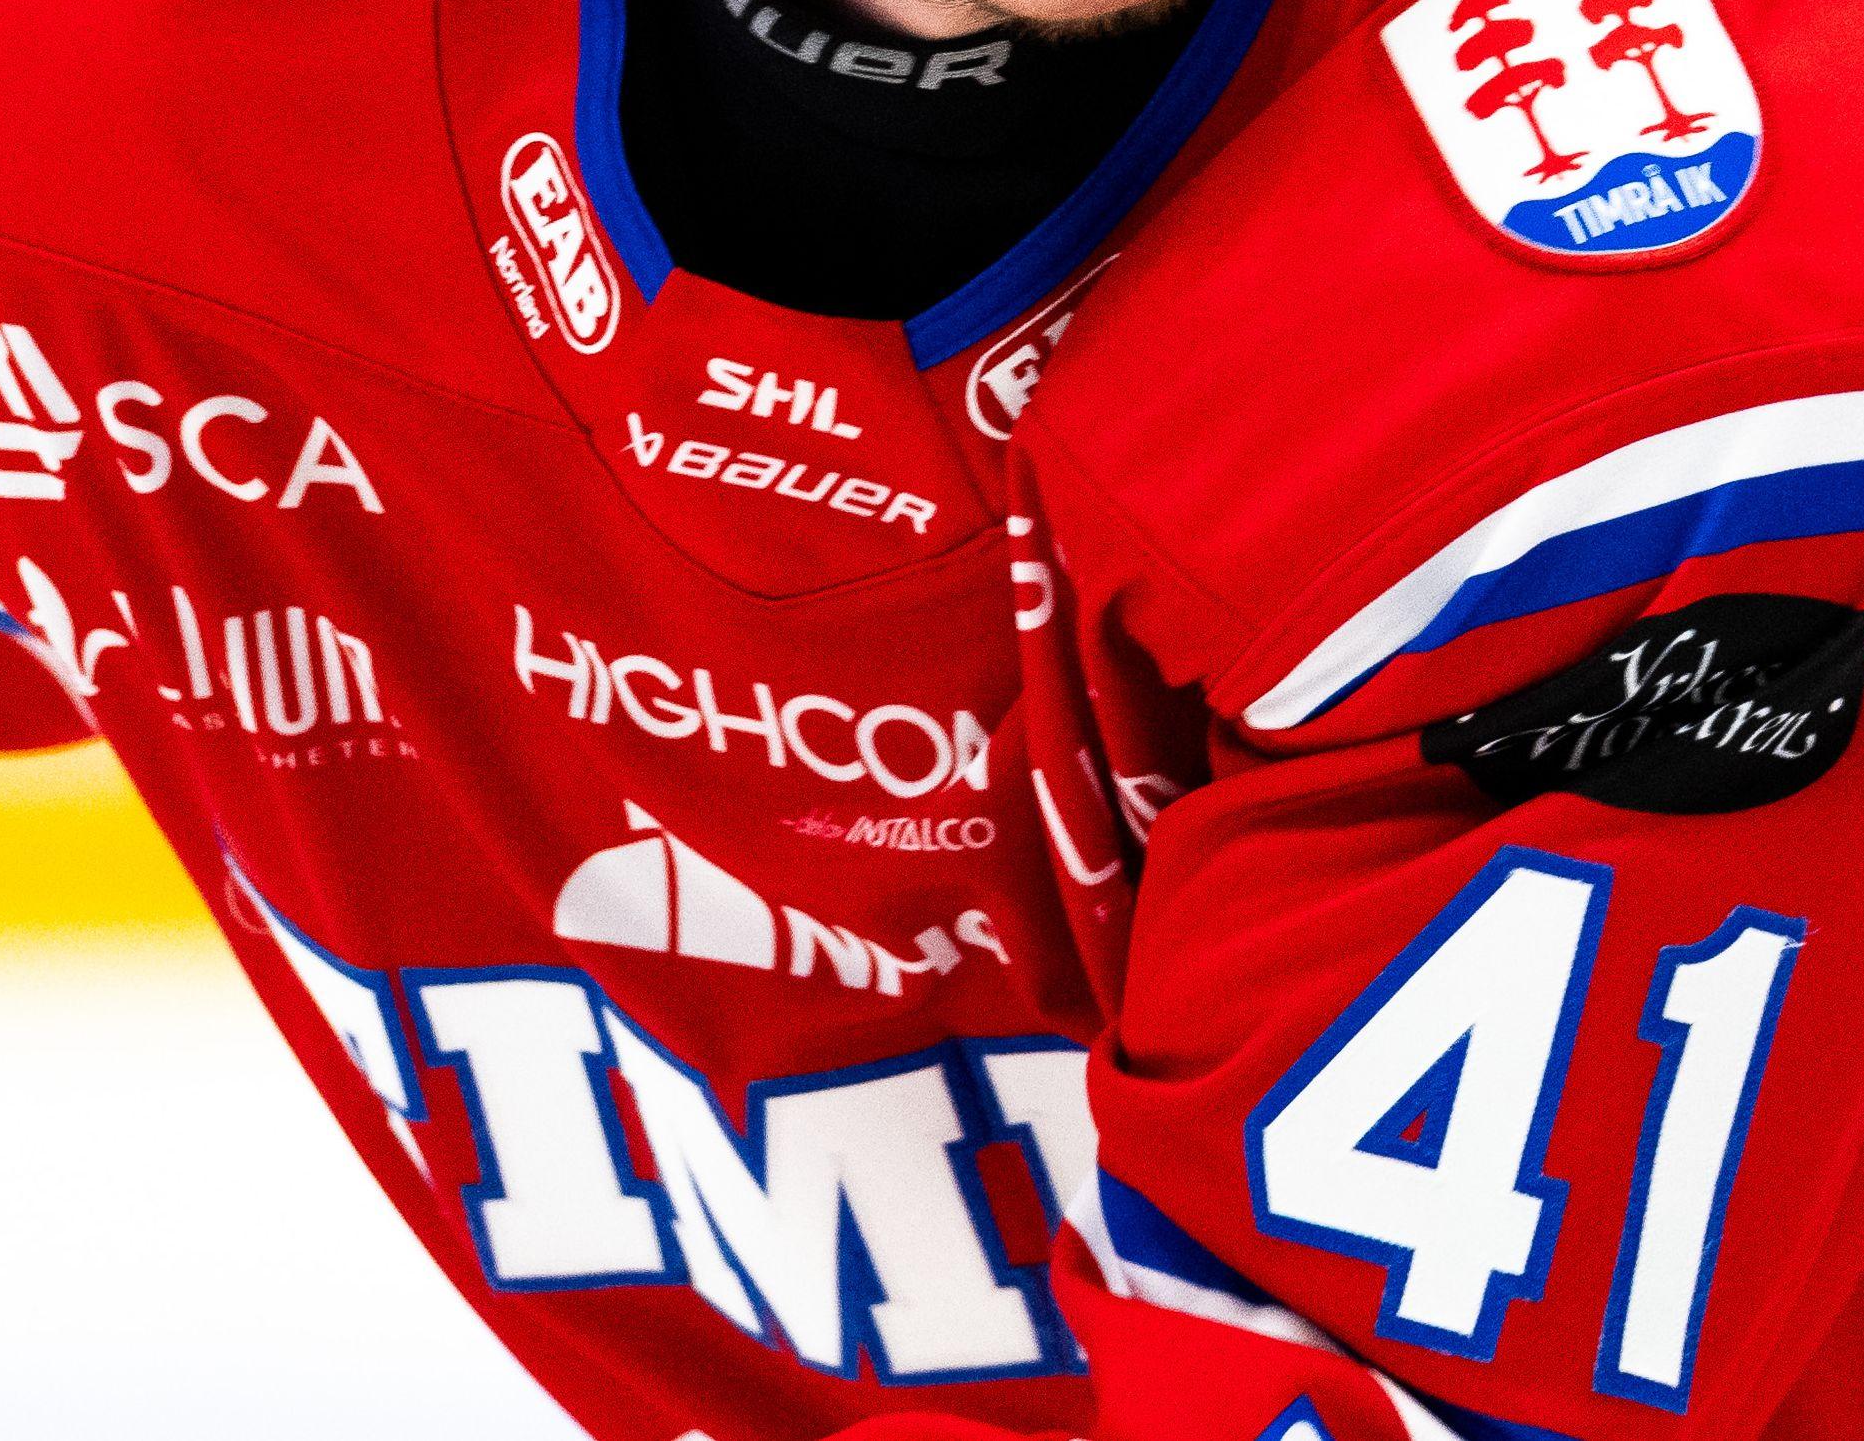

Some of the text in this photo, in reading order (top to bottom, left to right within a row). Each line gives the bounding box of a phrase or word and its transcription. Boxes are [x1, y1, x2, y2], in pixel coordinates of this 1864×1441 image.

[509, 145, 609, 339] EAB
[1553, 161, 1728, 246] TIMRÅ IK
[95, 379, 386, 515] SCA
[697, 356, 863, 441] SHL
[844, 815, 997, 852] INSTALCO
[1241, 843, 1809, 1416] 41
